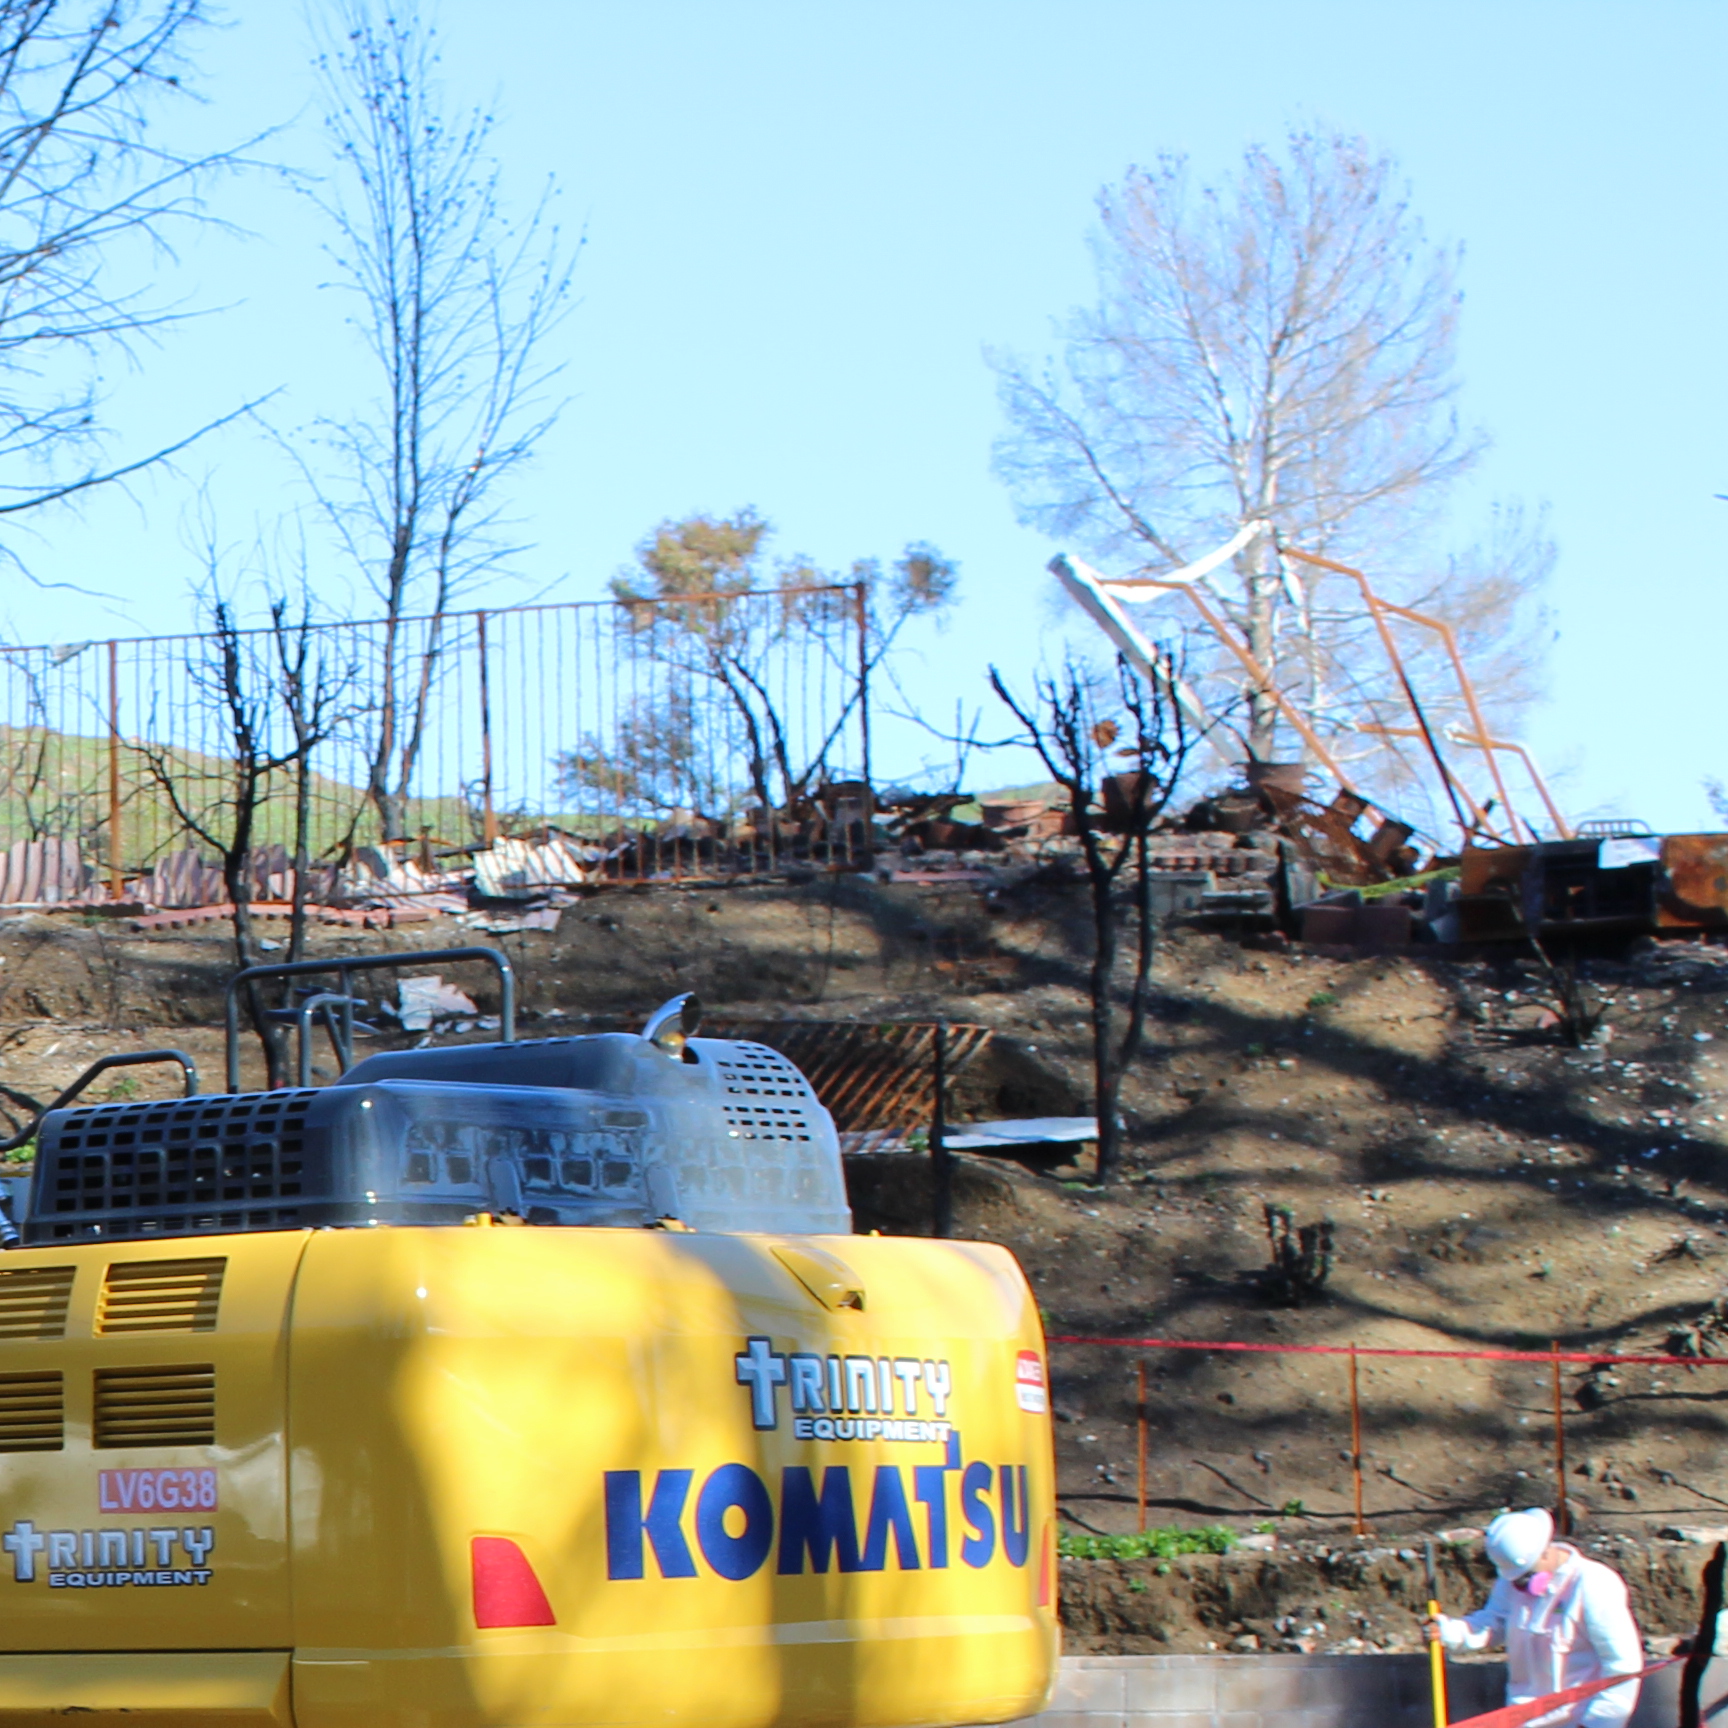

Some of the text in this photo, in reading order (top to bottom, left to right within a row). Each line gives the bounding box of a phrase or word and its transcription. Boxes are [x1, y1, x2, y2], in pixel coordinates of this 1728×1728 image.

[794, 1418, 951, 1441] EQUIPMENT
[100, 1470, 216, 1511] LV6G38
[604, 1430, 1029, 1581] KOMATSU
[48, 1569, 213, 1588] EQUIPMENT
